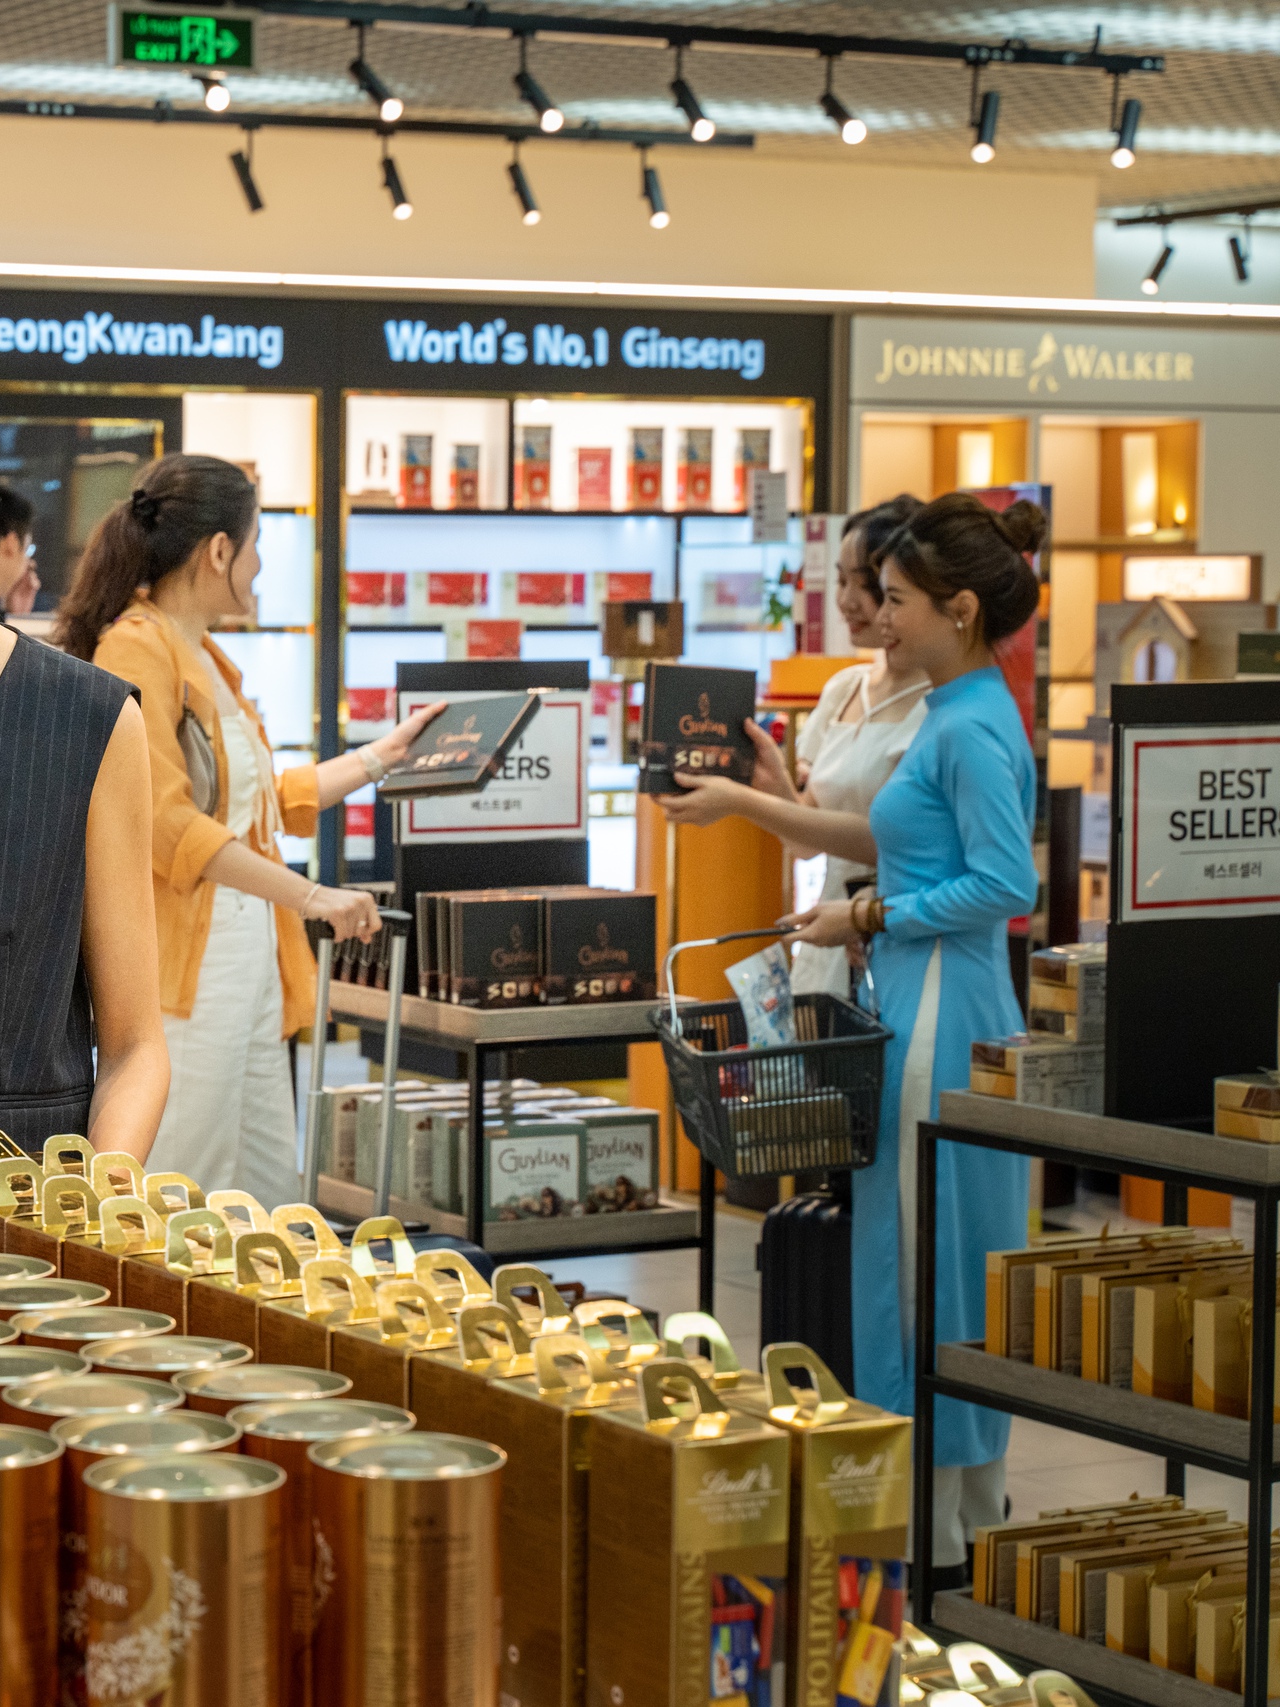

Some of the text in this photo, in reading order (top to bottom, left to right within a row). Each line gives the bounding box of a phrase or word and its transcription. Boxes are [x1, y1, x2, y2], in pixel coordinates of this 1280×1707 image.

[384, 318, 766, 380] World's No.1 Ginseng
[875, 339, 1195, 384] JOHNNIE WALKER
[493, 756, 552, 780] ERS
[1199, 768, 1273, 800] BEST
[1169, 807, 1280, 841] SELLER
